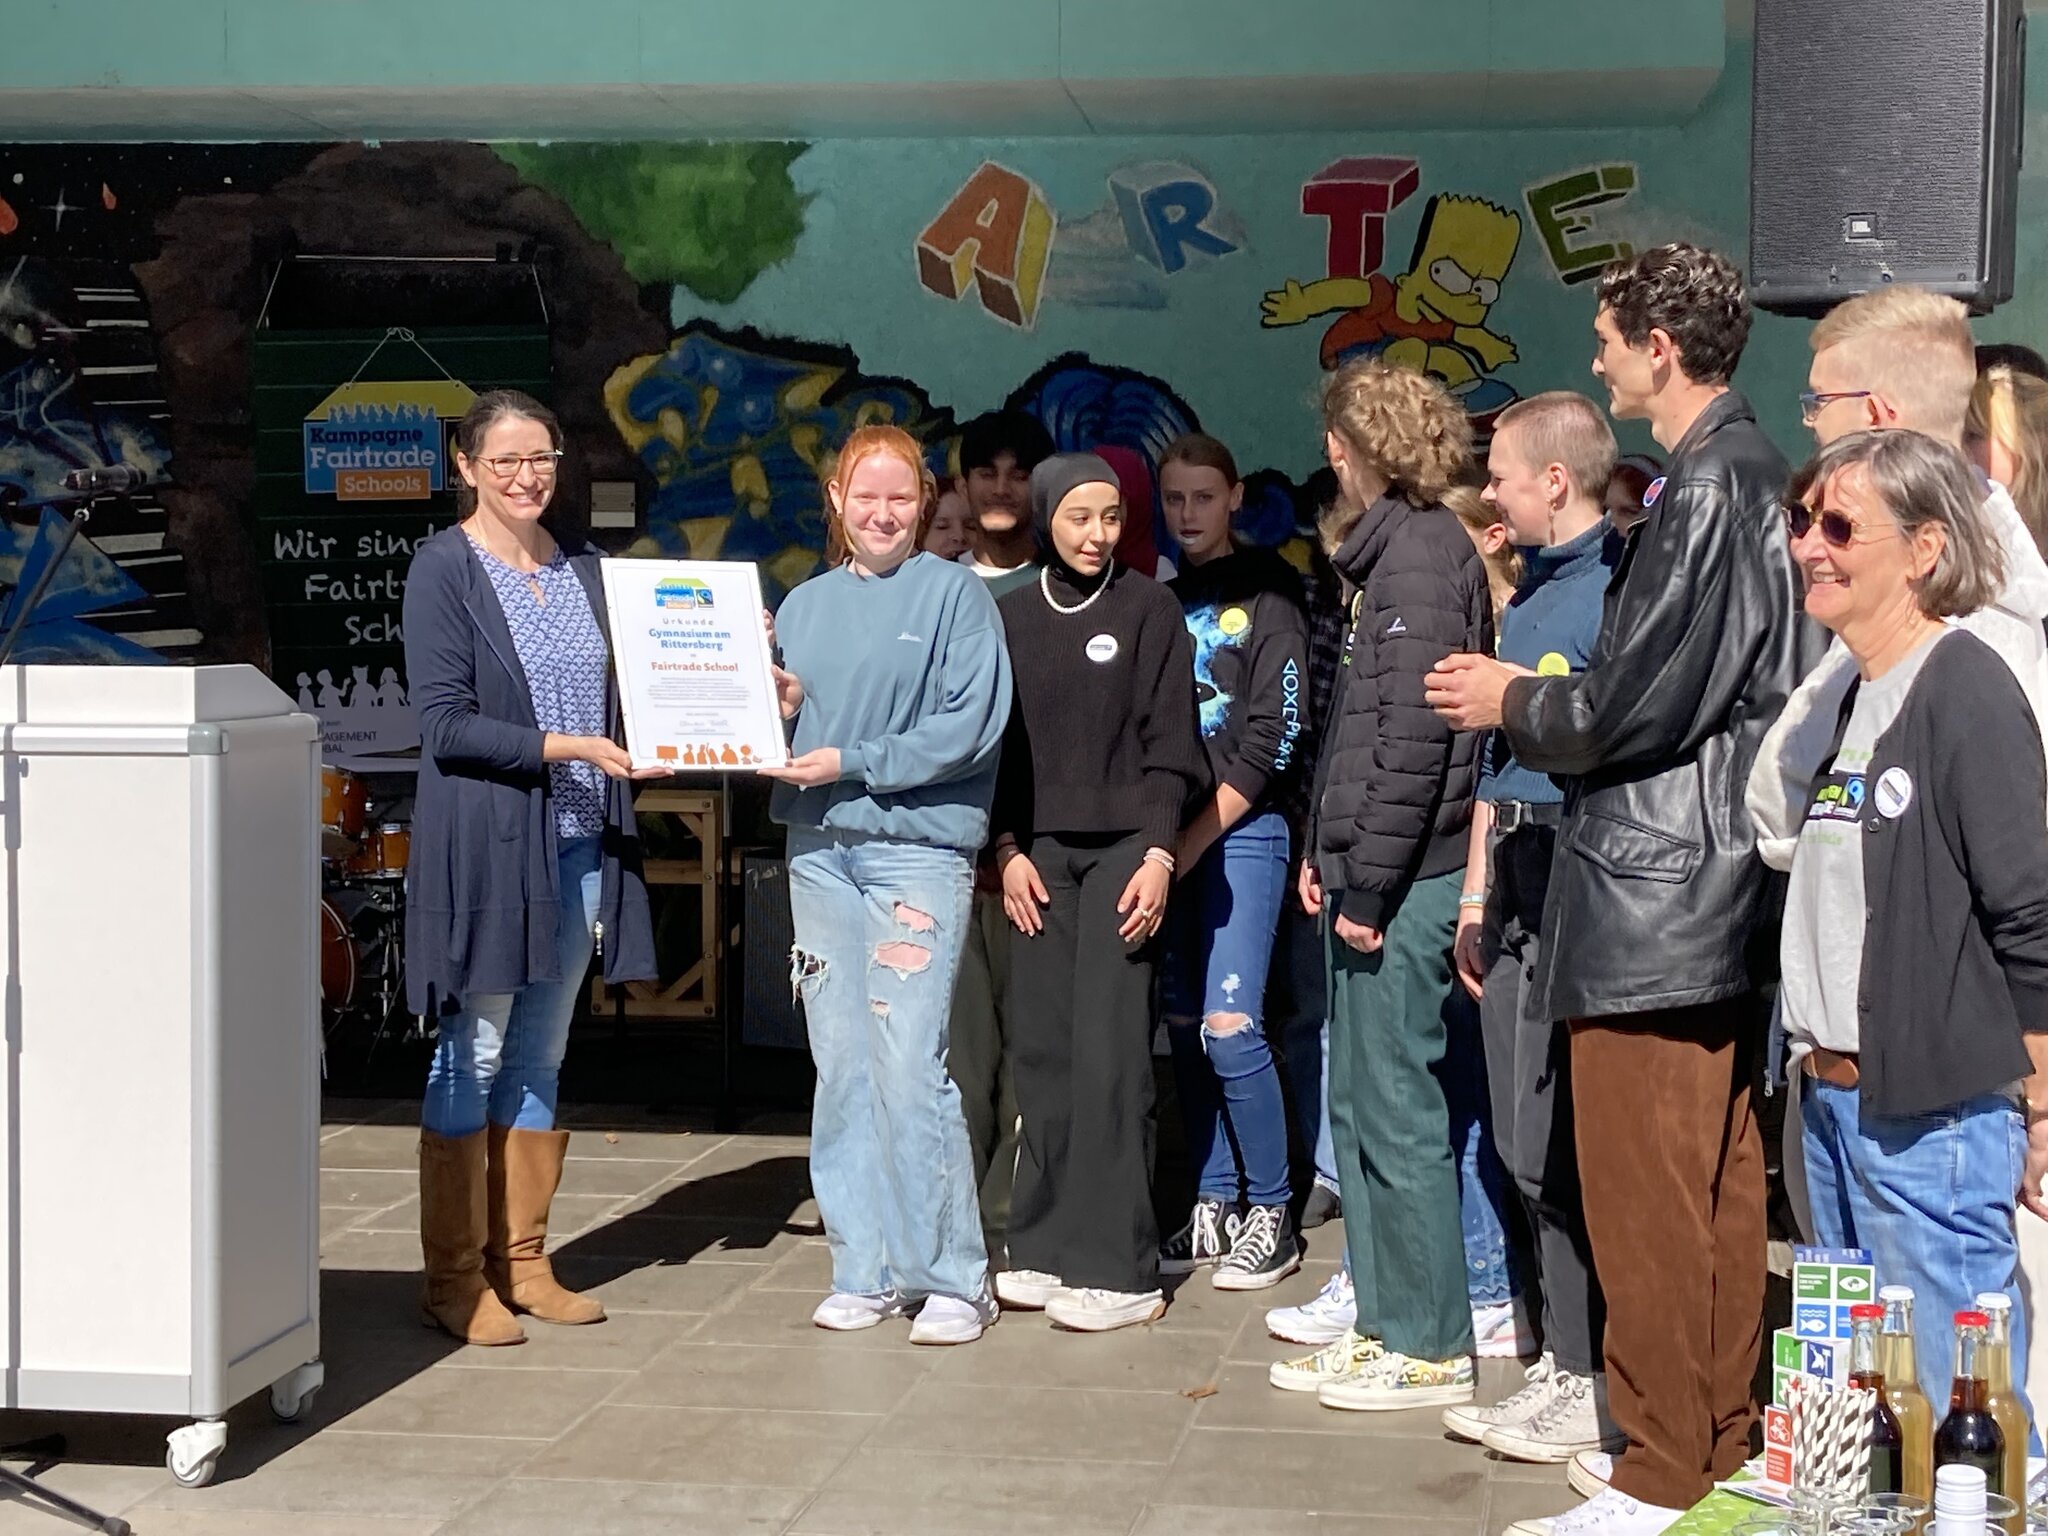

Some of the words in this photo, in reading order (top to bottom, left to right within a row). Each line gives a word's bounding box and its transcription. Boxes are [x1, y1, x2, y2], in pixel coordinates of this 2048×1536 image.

[310, 427, 423, 447] Kampagne
[310, 445, 436, 468] Fairtrade
[344, 476, 421, 493] Schools
[275, 529, 338, 560] Wir
[305, 569, 408, 600] Fairt
[649, 628, 712, 639] Gymnasium
[661, 640, 723, 651] Rittersberg
[651, 661, 702, 671] Fairtrade
[703, 662, 739, 672] School
[323, 731, 377, 741] AGEMENT
